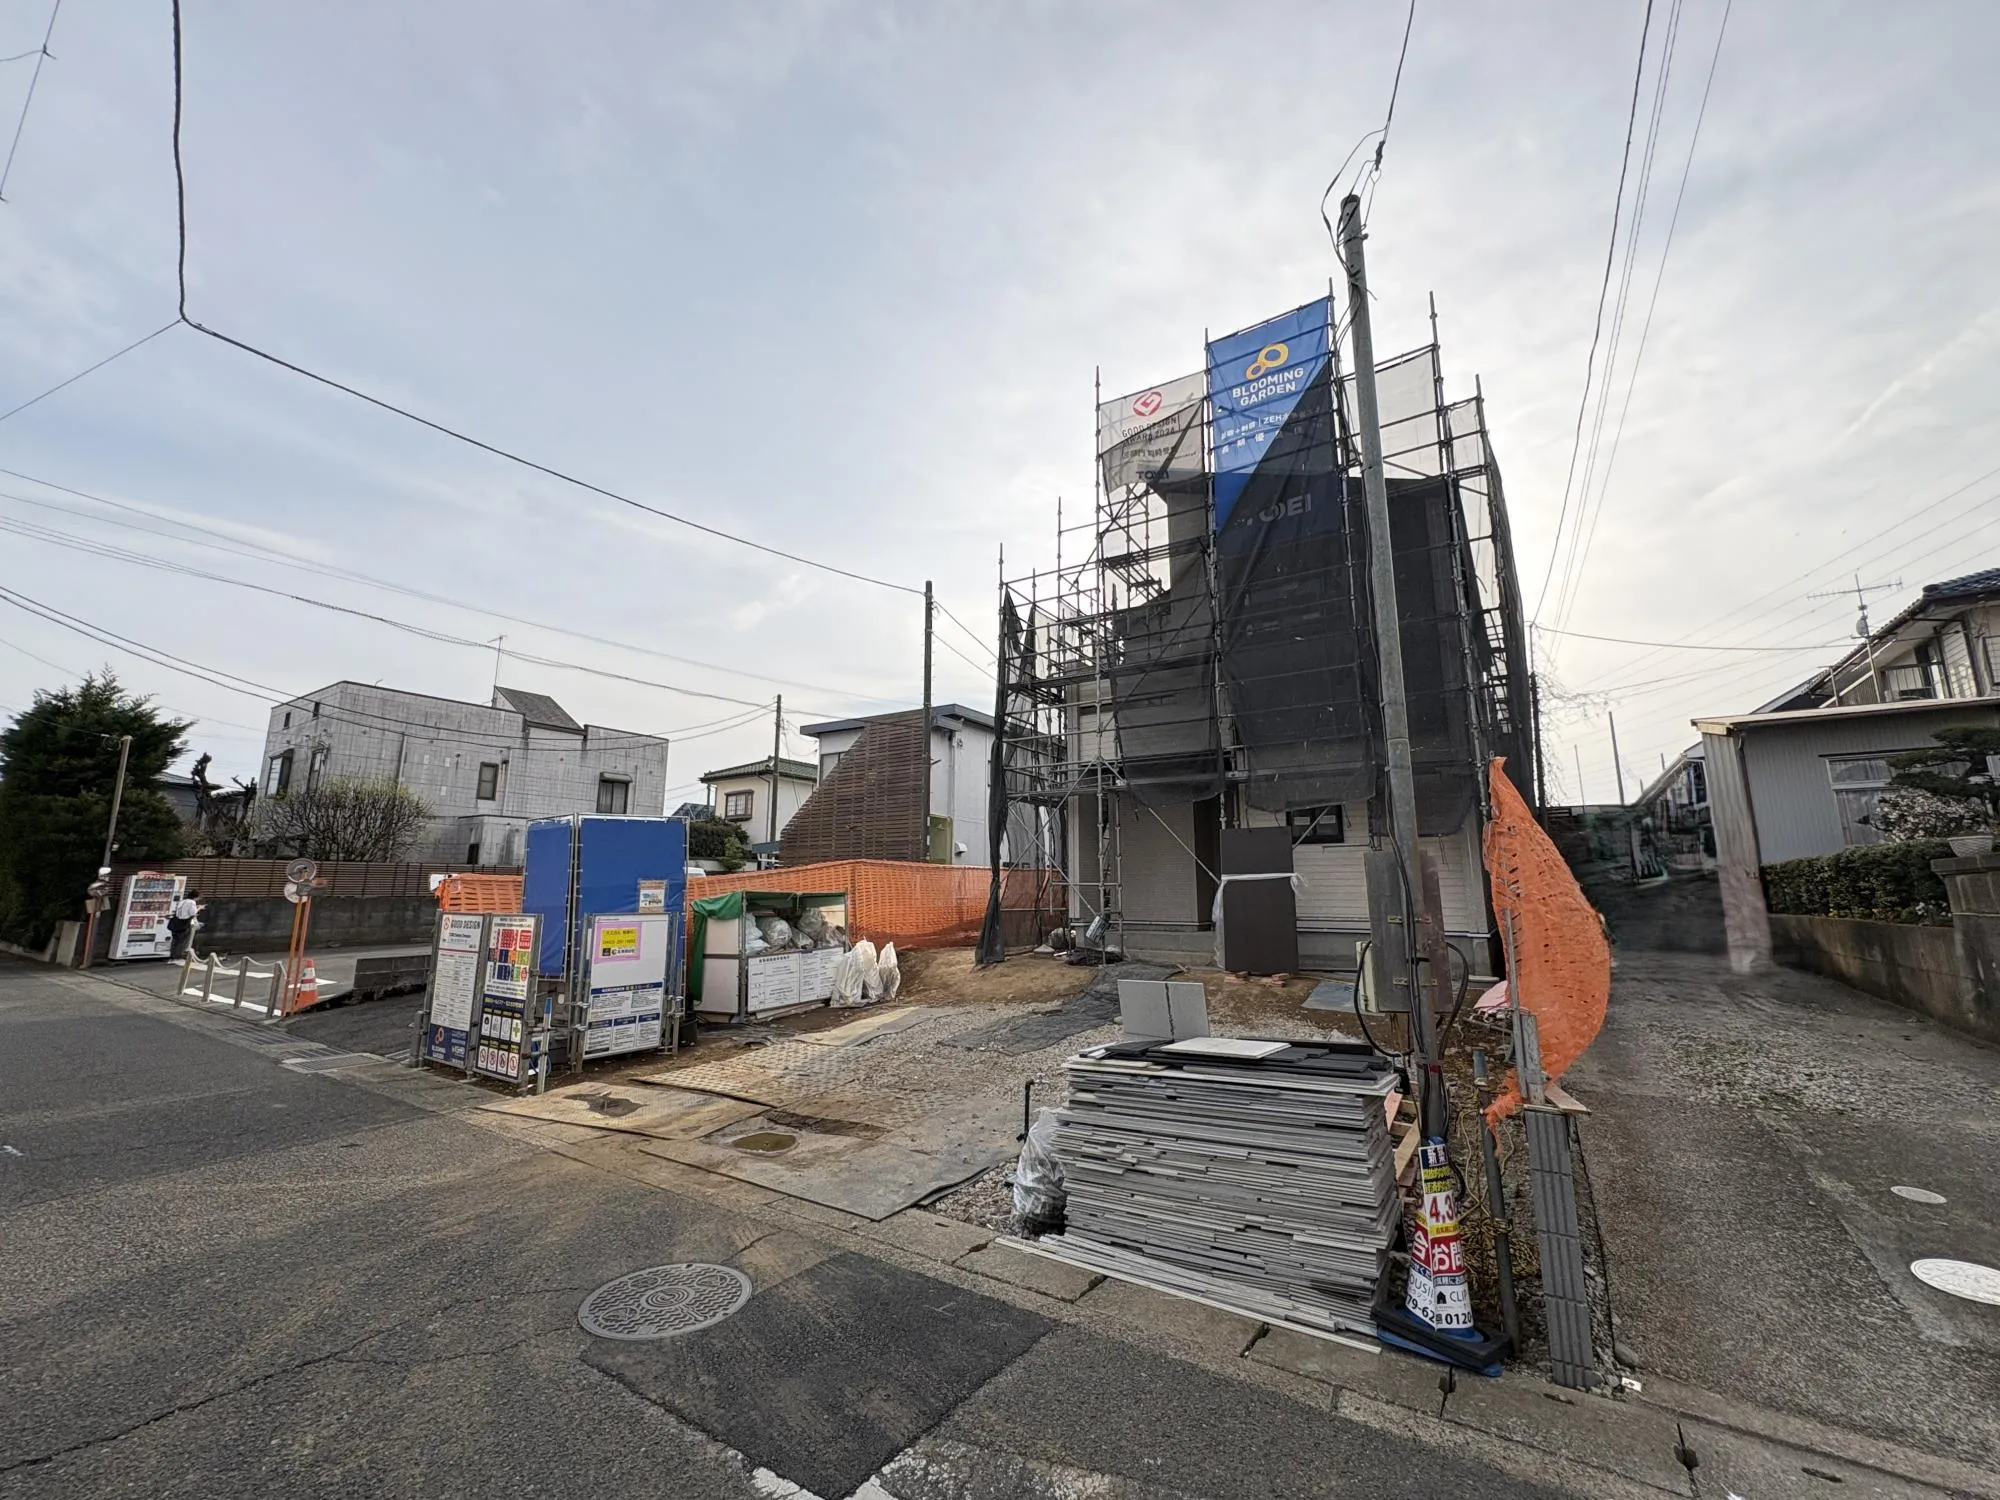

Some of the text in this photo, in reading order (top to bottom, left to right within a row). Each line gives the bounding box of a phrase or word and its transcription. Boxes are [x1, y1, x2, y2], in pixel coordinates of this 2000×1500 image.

[1232, 367, 1304, 398] BLOOMING
[1240, 382, 1296, 406] GARDEN
[1122, 417, 1177, 438] GOOD DESIGN
[1445, 1311, 1473, 1326] 0120
